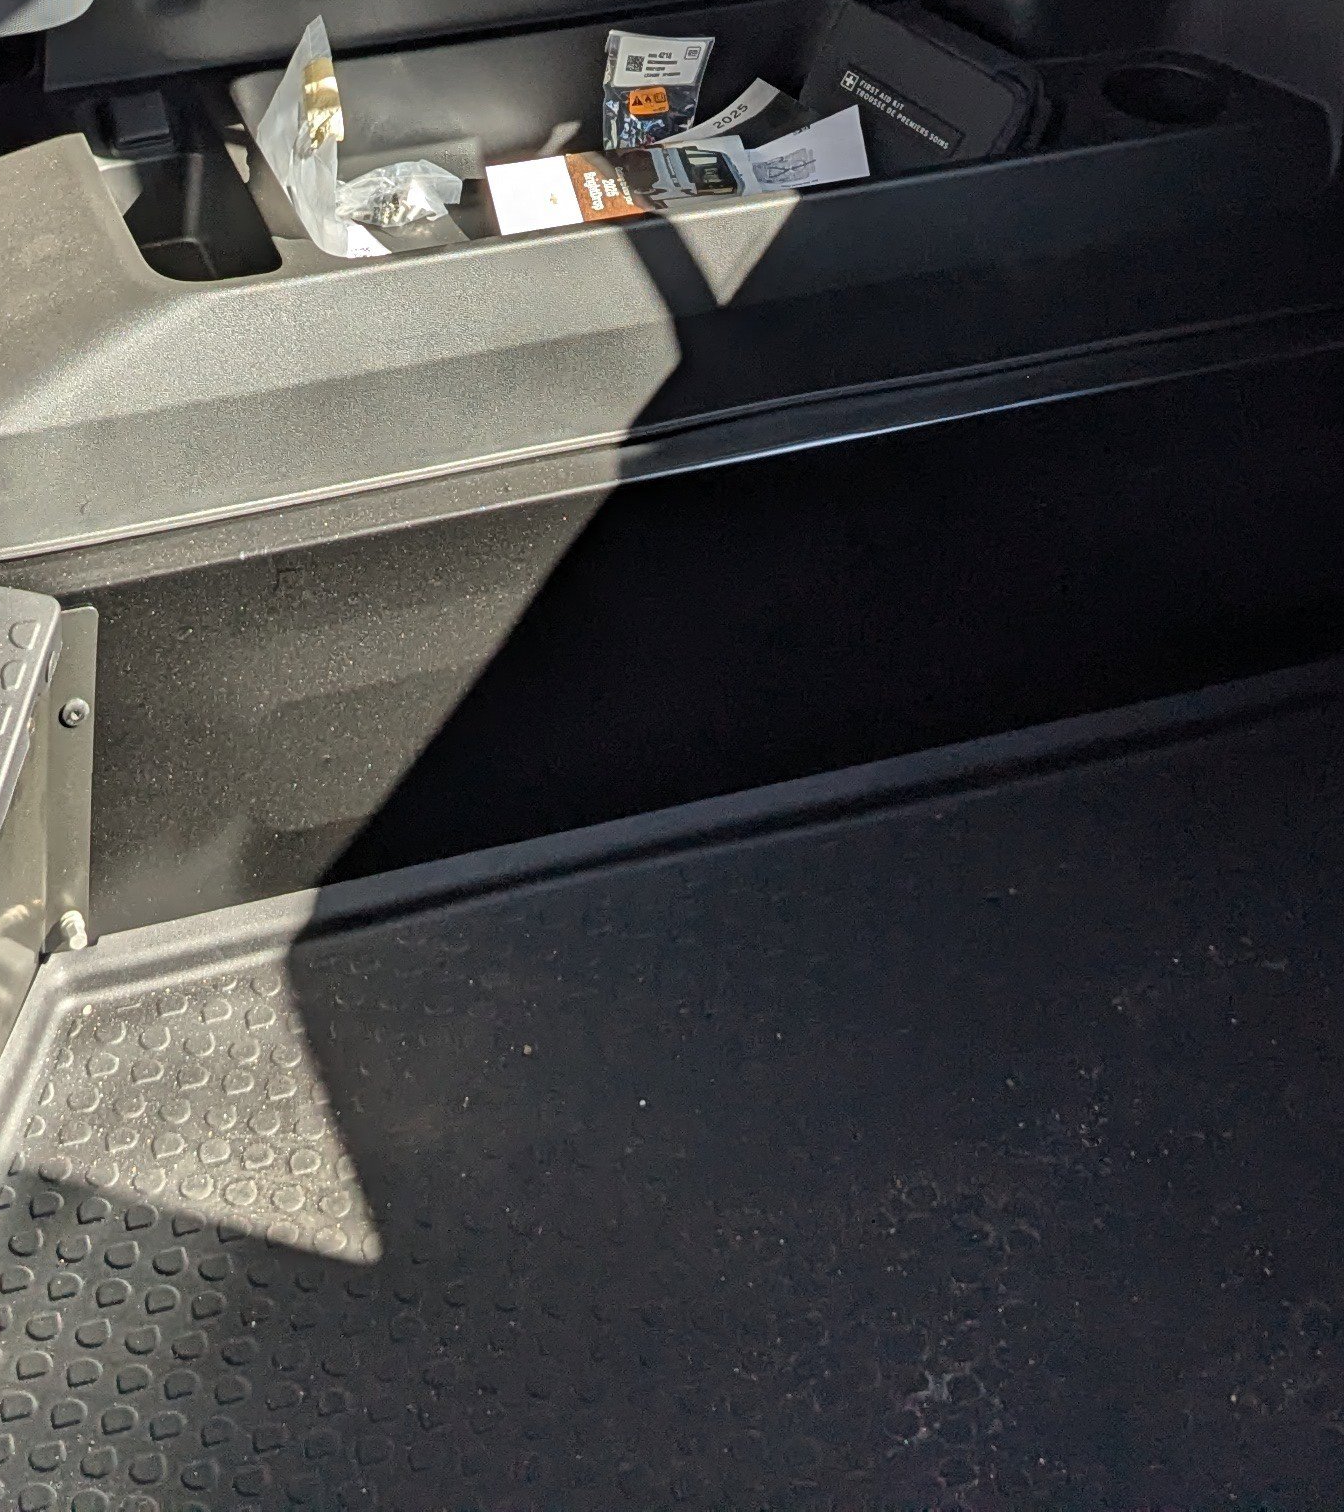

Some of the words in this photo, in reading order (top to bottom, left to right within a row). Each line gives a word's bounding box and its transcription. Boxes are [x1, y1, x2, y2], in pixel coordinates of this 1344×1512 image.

[859, 79, 880, 96] FIRST
[879, 92, 892, 104] AID
[892, 100, 905, 110] KIT
[712, 103, 748, 129] 2025
[855, 88, 886, 111] TROUSSE
[886, 106, 896, 117] DE
[896, 113, 929, 138] PREMIERS
[929, 133, 949, 150] SOINS
